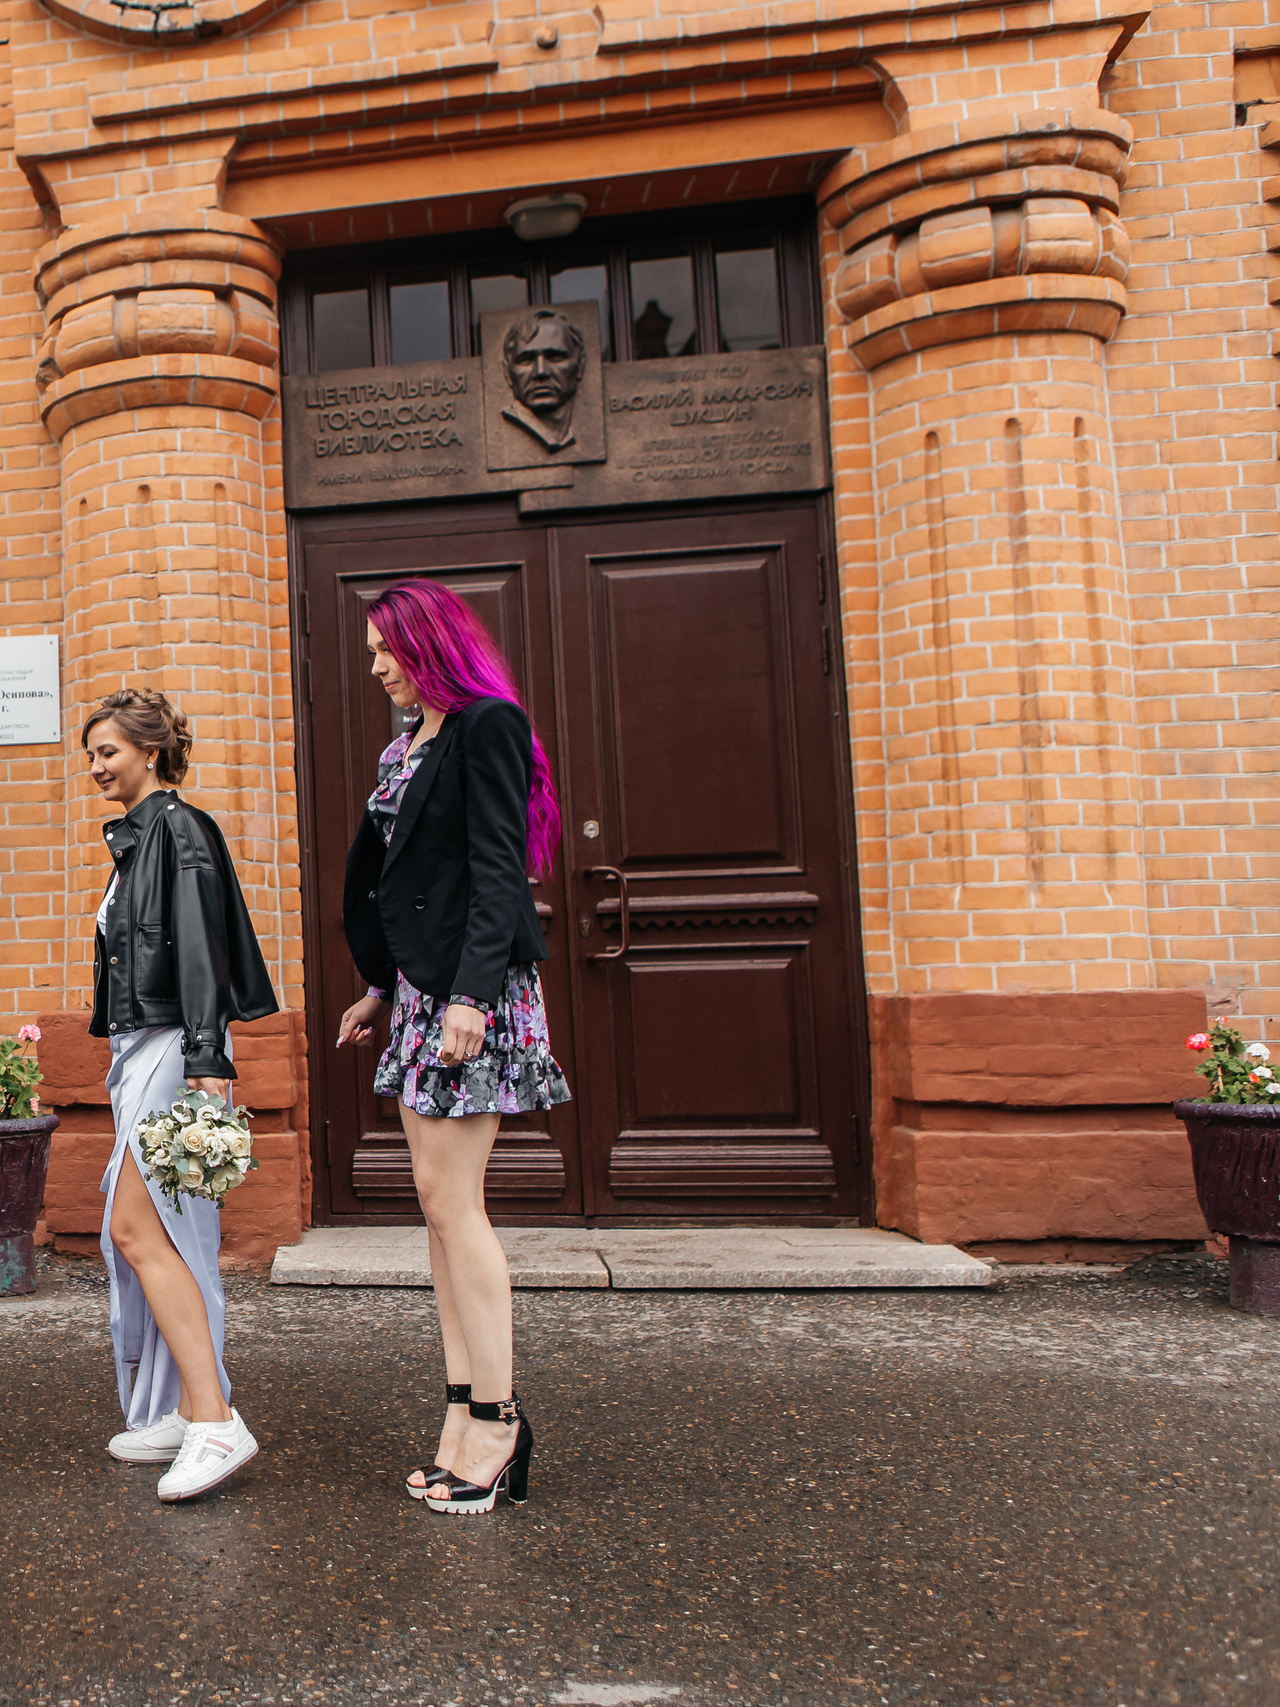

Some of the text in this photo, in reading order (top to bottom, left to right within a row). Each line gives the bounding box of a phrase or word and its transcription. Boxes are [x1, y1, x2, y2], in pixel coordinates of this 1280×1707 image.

[306, 374, 468, 409] ЦЕНТРАЛЬНАЯ
[609, 381, 814, 413] ВАСИЛИЙ МАКАРОВИЧ
[318, 401, 456, 432] ГОРОДСКАЯ
[670, 405, 753, 427] ШУКШИН
[314, 427, 464, 458] БИБЛИОТЕКА
[701, 429, 784, 449] ВСТРЕТИЛСЯ
[729, 441, 812, 462] БИБЛИОТЕКЕ
[317, 472, 364, 487] ИМЕНИ
[647, 465, 731, 483] ЧИТАТЕЛЯМИ
[739, 461, 795, 477] ГОРОДА
[4, 668, 34, 676] НАСЛЕДИЯ
[1, 705, 10, 713] г.
